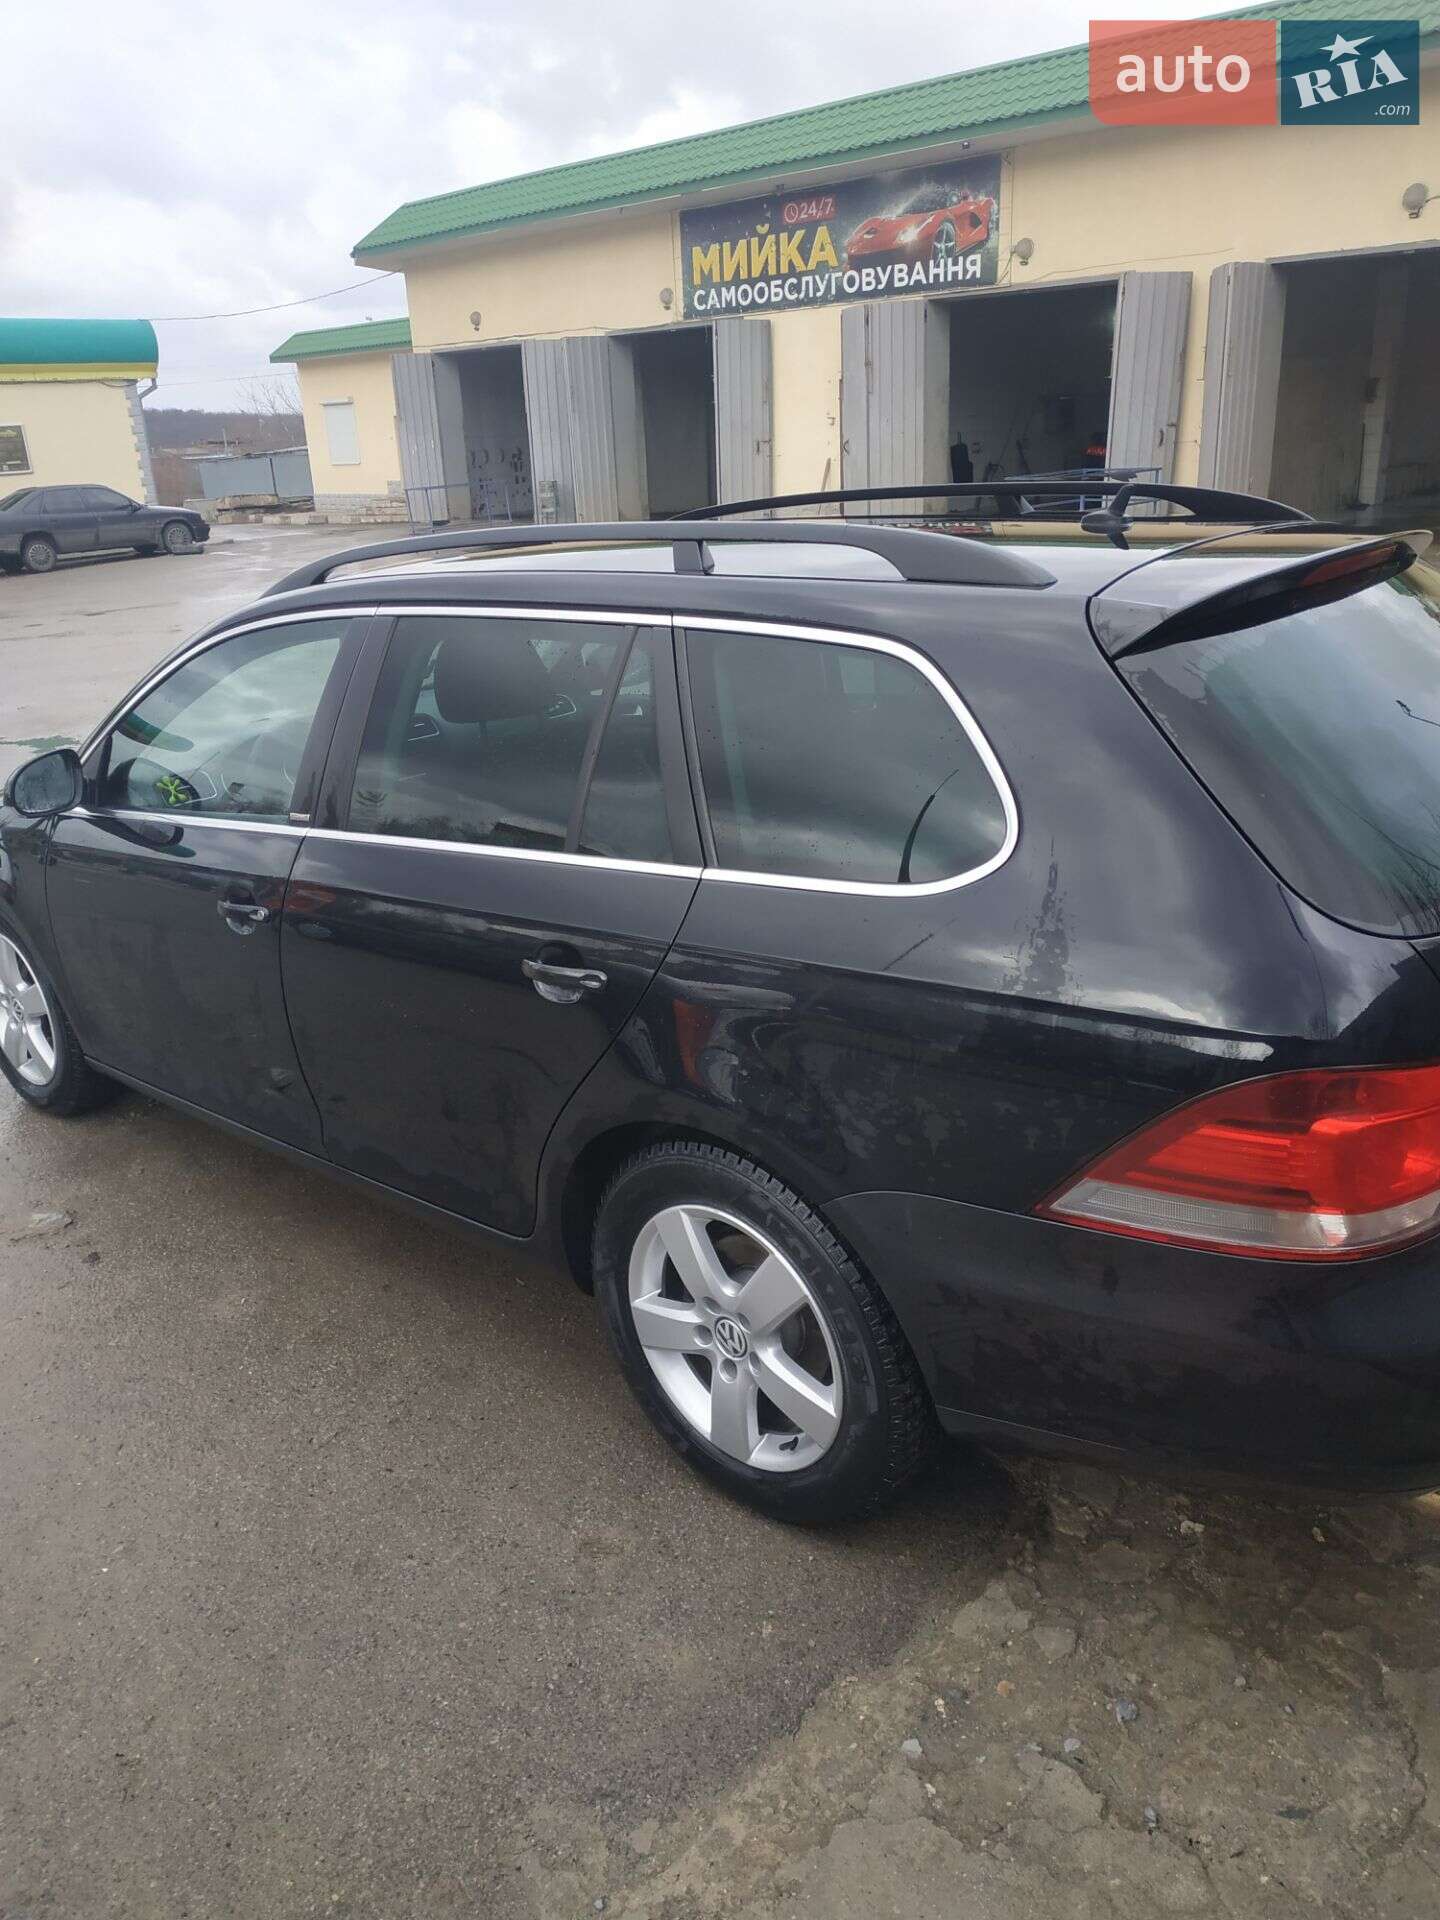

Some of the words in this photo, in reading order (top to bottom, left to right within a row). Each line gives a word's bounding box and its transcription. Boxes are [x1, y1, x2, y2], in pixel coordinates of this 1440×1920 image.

[800, 197, 833, 219] 24/7
[691, 223, 840, 286] МИЙКА
[692, 253, 982, 311] САМООБСЛУГОВУВАННЯ
